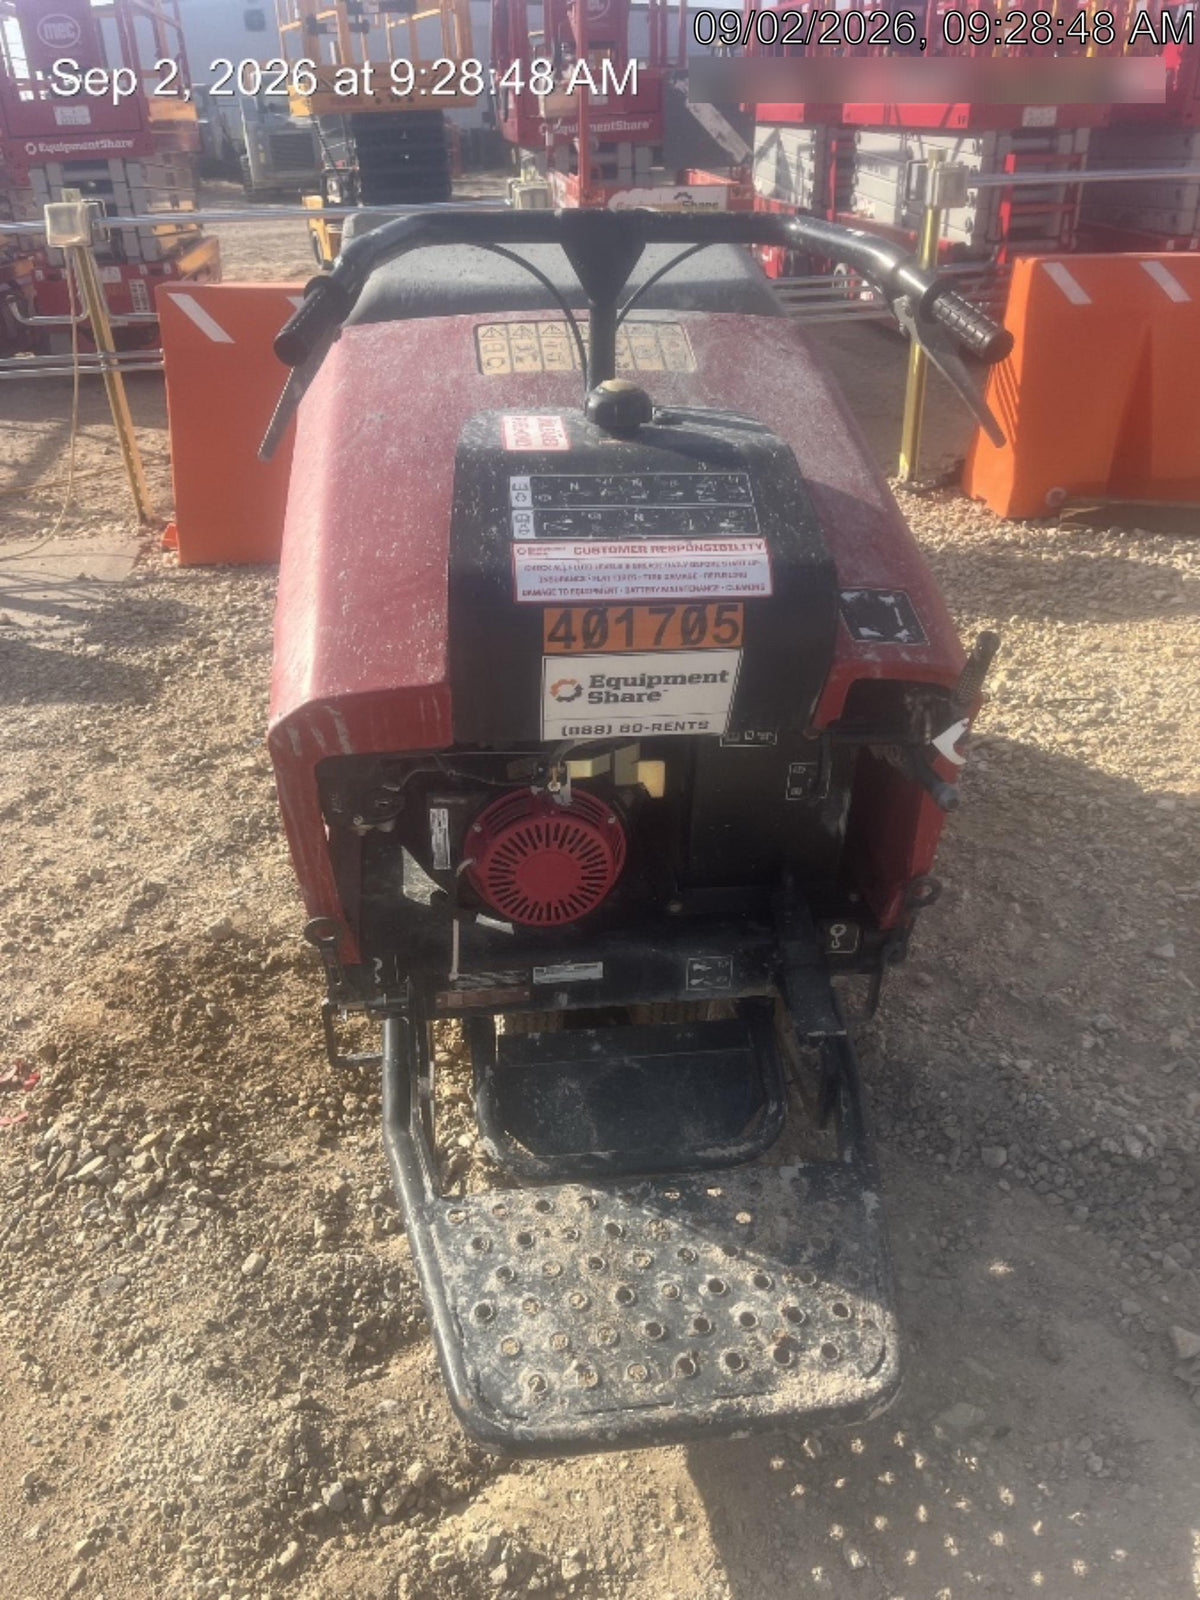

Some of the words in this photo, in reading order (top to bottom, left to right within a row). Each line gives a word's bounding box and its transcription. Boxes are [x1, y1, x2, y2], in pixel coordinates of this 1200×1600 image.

[573, 545, 648, 556] CUSTOMER
[588, 670, 729, 689] Equipment
[588, 690, 663, 704] Share
